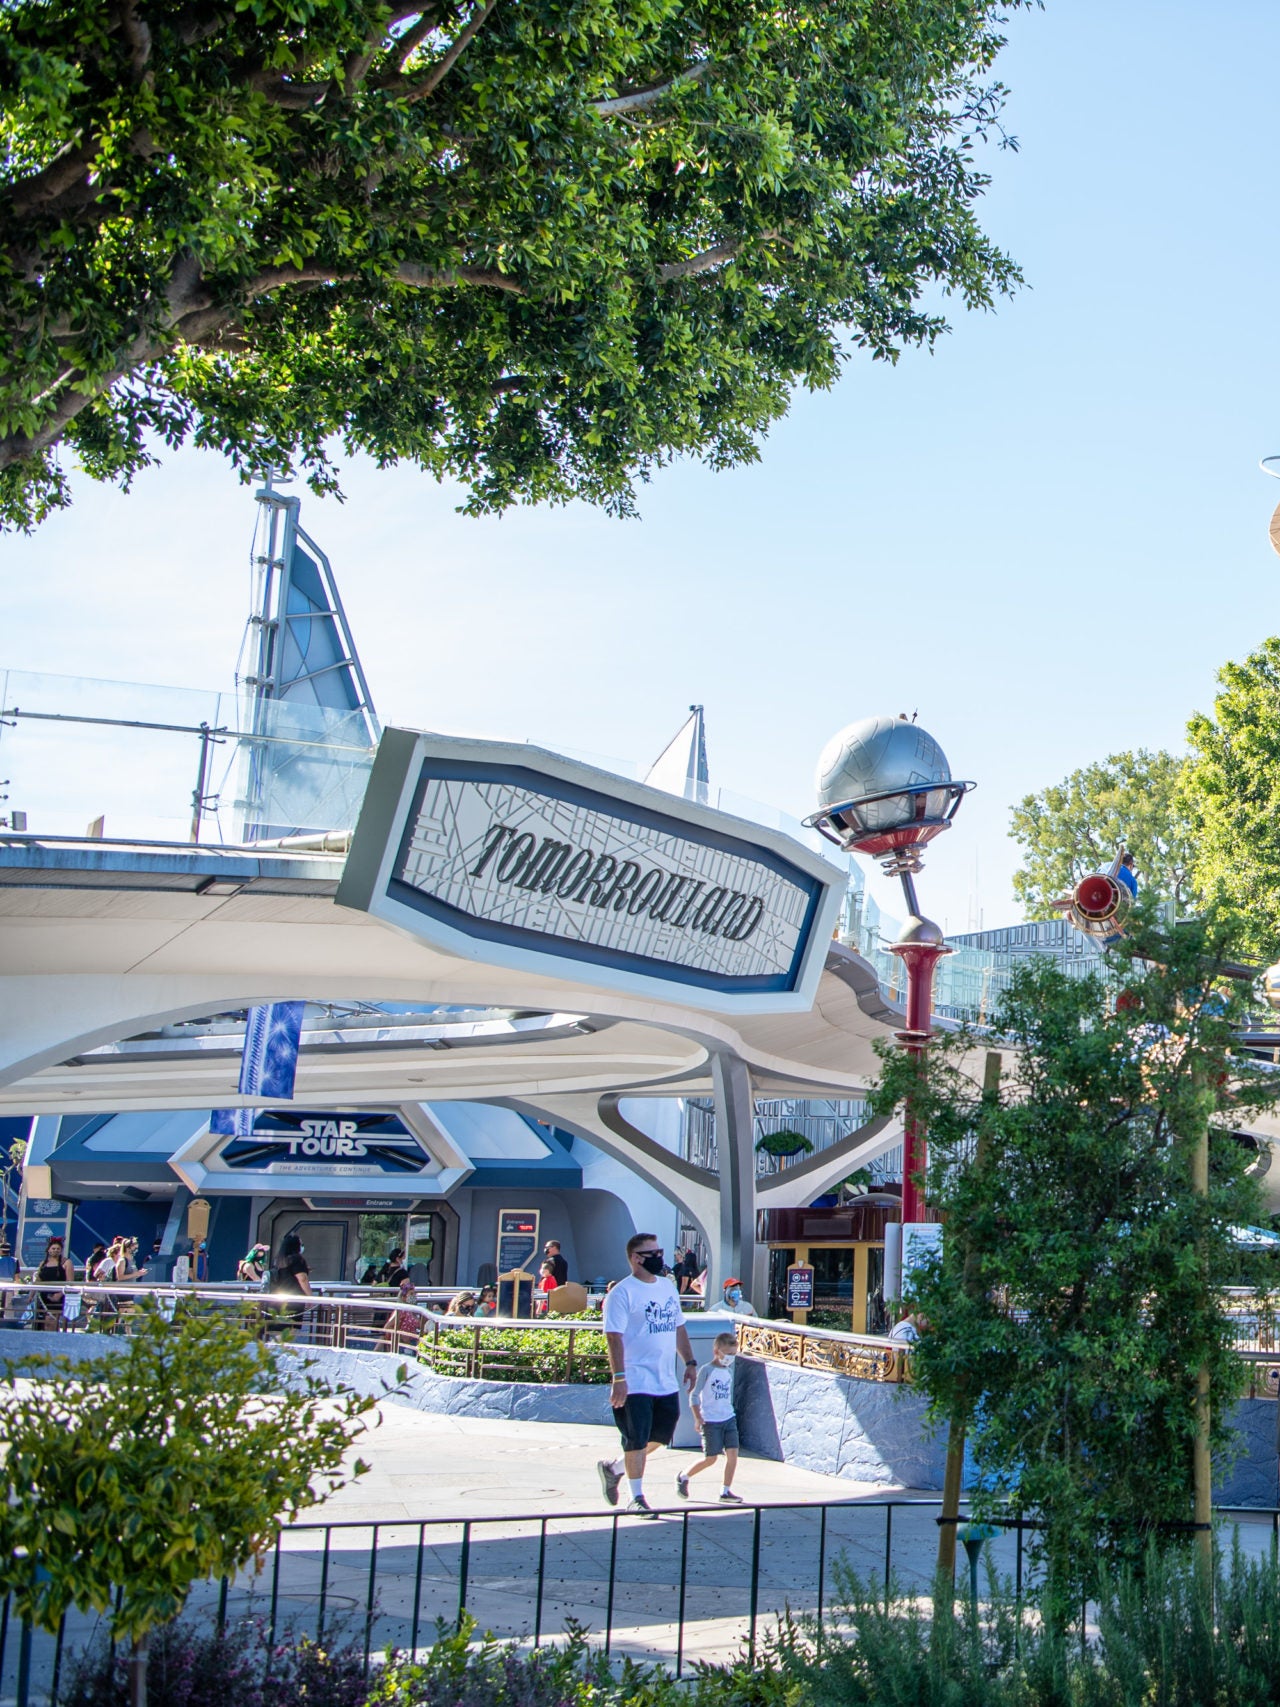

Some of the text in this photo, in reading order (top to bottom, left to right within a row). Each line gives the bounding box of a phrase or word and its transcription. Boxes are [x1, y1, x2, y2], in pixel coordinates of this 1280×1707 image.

[469, 823, 766, 942] TOMORROWLAND
[300, 1119, 358, 1138] STAR
[288, 1137, 368, 1156] TOURS
